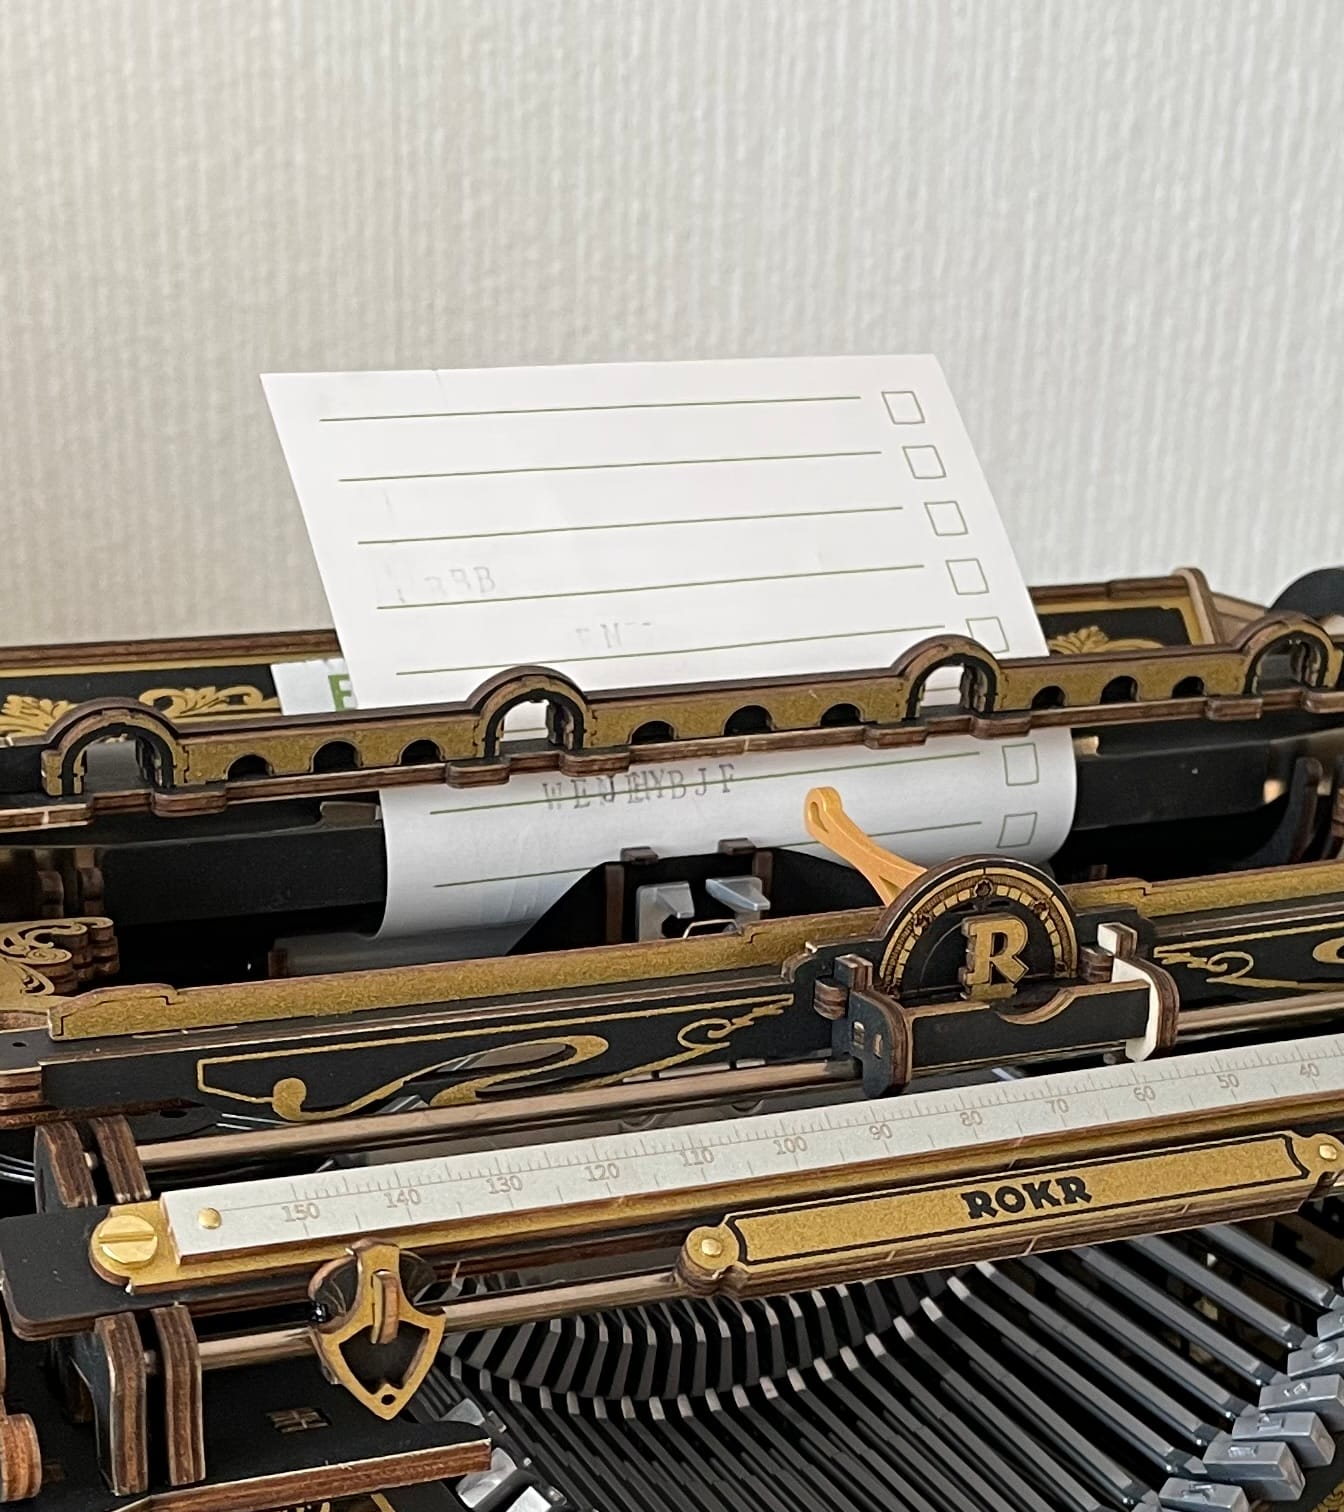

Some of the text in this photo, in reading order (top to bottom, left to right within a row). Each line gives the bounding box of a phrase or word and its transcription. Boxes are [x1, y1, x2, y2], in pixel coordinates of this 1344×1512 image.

[959, 912, 1030, 988] R
[280, 1202, 321, 1223] 150
[383, 1188, 422, 1209] 140
[486, 1174, 523, 1195] 130
[584, 1162, 620, 1182] 120
[680, 1149, 715, 1167] 110
[774, 1135, 807, 1155] 100
[869, 1123, 893, 1141] 90
[959, 1110, 983, 1127] 80
[1045, 1098, 1069, 1115] 70
[1133, 1085, 1157, 1102] 60
[1216, 1073, 1240, 1089] 50
[1299, 1062, 1321, 1079] 40
[960, 1175, 1093, 1220] ROKR
